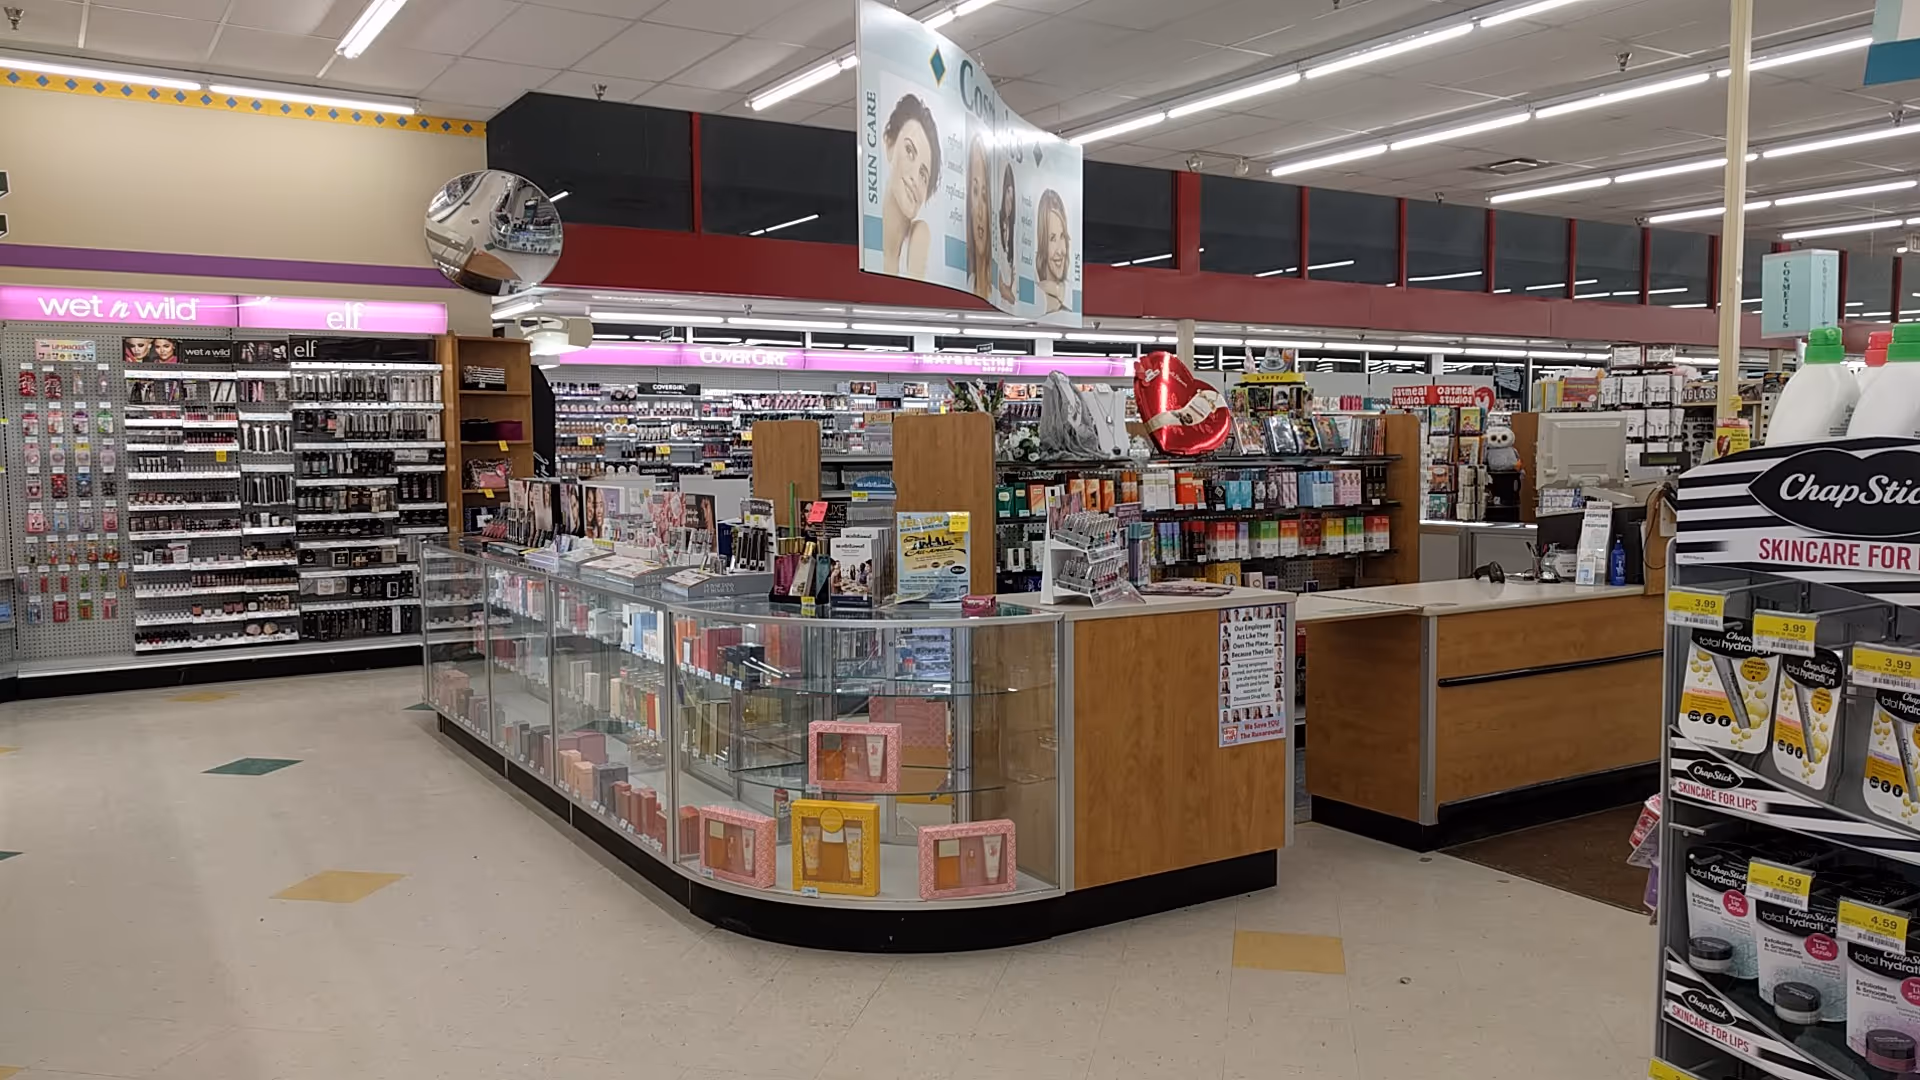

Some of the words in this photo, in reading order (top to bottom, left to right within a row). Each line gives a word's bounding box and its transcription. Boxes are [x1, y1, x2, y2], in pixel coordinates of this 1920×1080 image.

[866, 91, 877, 148] CARE
[868, 154, 878, 205] SKIN
[1782, 261, 1791, 329] COSMETICS
[37, 295, 104, 318] wet
[109, 300, 130, 319] n
[134, 297, 198, 321] wild
[185, 347, 204, 356] wet
[212, 348, 231, 356] wild
[1682, 388, 1717, 400] NGLASS
[1758, 538, 1861, 567] SKINCARE
[1868, 545, 1912, 570] FOR
[1694, 598, 1716, 609] 3.99
[1782, 622, 1807, 634] 3.99
[1699, 636, 1720, 647] total
[1726, 631, 1754, 643] Chap
[1786, 663, 1800, 675] total
[1803, 660, 1837, 676] ChapStick
[1884, 657, 1912, 670] 3.99
[1881, 696, 1898, 709] total
[1693, 765, 1735, 783] ChapStick
[1678, 781, 1717, 801] SKINCARE
[1718, 791, 1735, 806] FOR
[1737, 796, 1757, 811] LIPS
[1690, 866, 1707, 879] total
[1710, 864, 1748, 881] ChapStick
[1777, 874, 1802, 888] 4.59
[1728, 903, 1744, 914] Scrub
[1731, 898, 1740, 907] Lip
[1761, 910, 1784, 923] total
[1785, 915, 1838, 934] hydration
[1788, 908, 1837, 924] ChapStick
[1870, 915, 1898, 930] 4.59
[1811, 947, 1832, 958] Scrub
[1815, 942, 1827, 951] Lip
[1854, 950, 1879, 965] total
[1855, 979, 1888, 992] Exfoliates
[1687, 994, 1729, 1020] ChapStick
[1671, 1004, 1710, 1033] SKINCARE
[1711, 1024, 1729, 1043] FOR
[1729, 1034, 1750, 1053] LIPS
